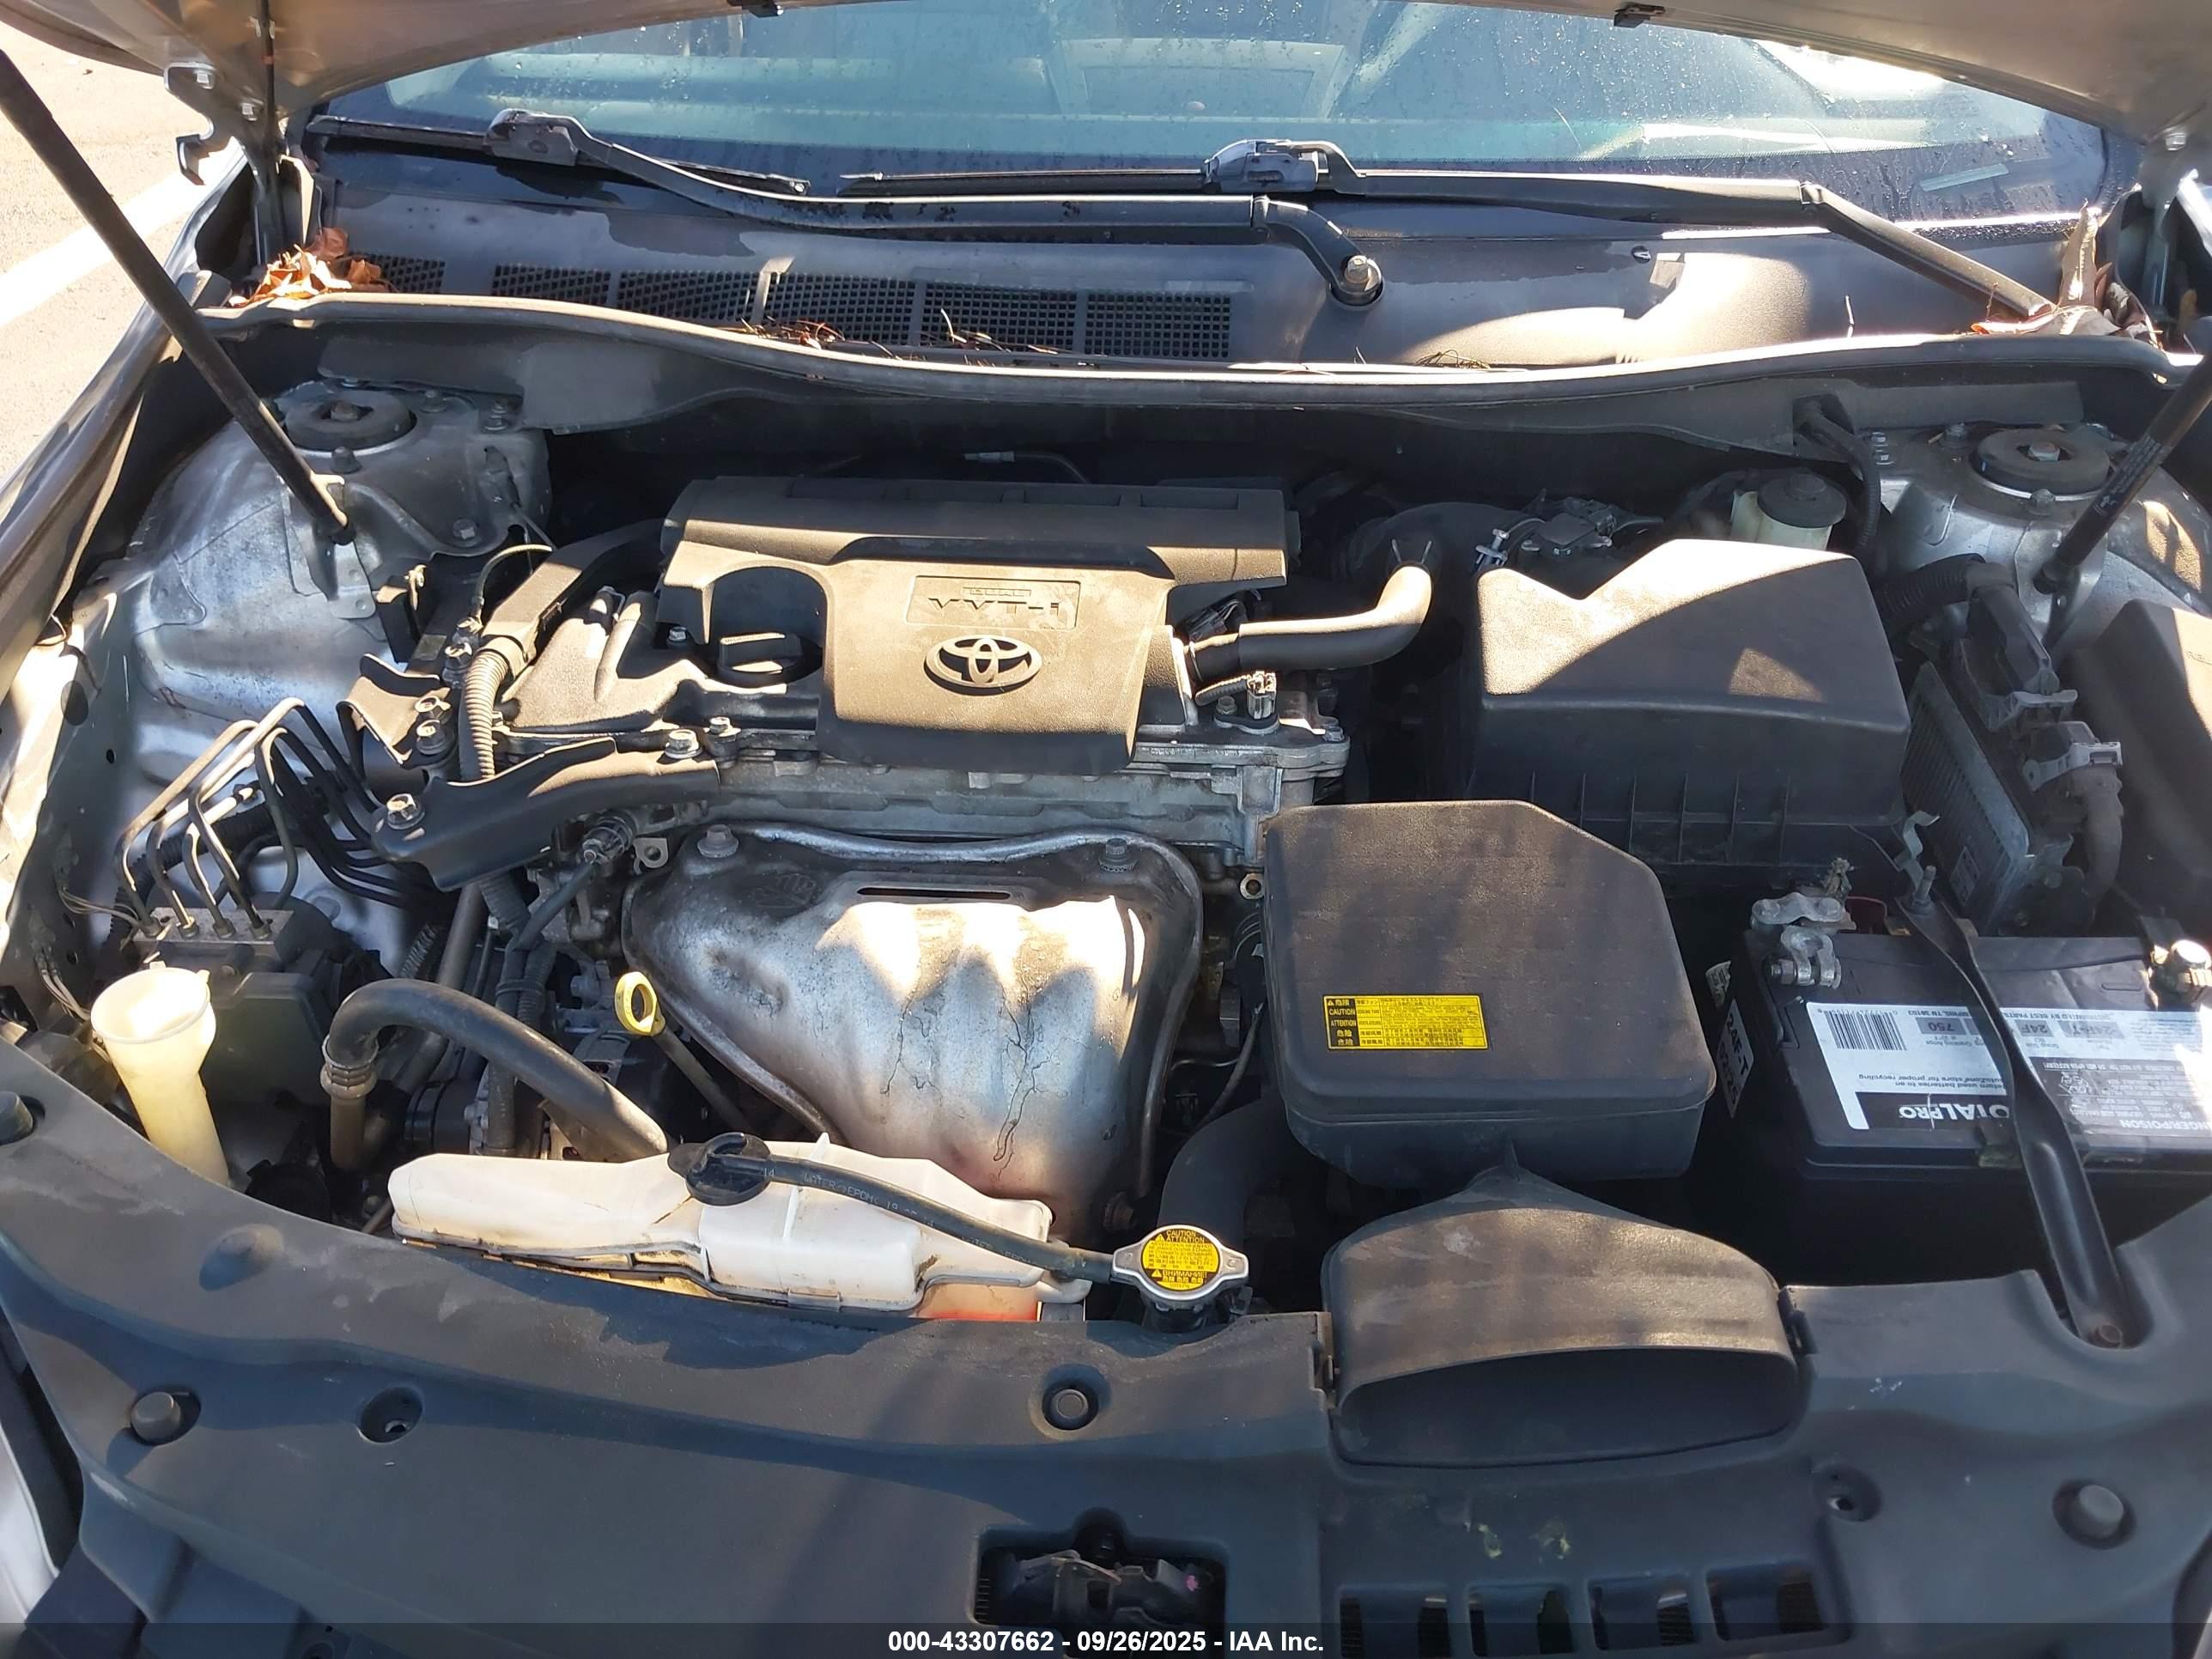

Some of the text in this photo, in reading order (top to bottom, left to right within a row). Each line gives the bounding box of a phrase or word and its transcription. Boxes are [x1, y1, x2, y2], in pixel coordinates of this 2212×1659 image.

[1929, 1023, 1954, 1031] 750
[2021, 1024, 2048, 1034] 24F
[1899, 1103, 2010, 1121] OTALPRO
